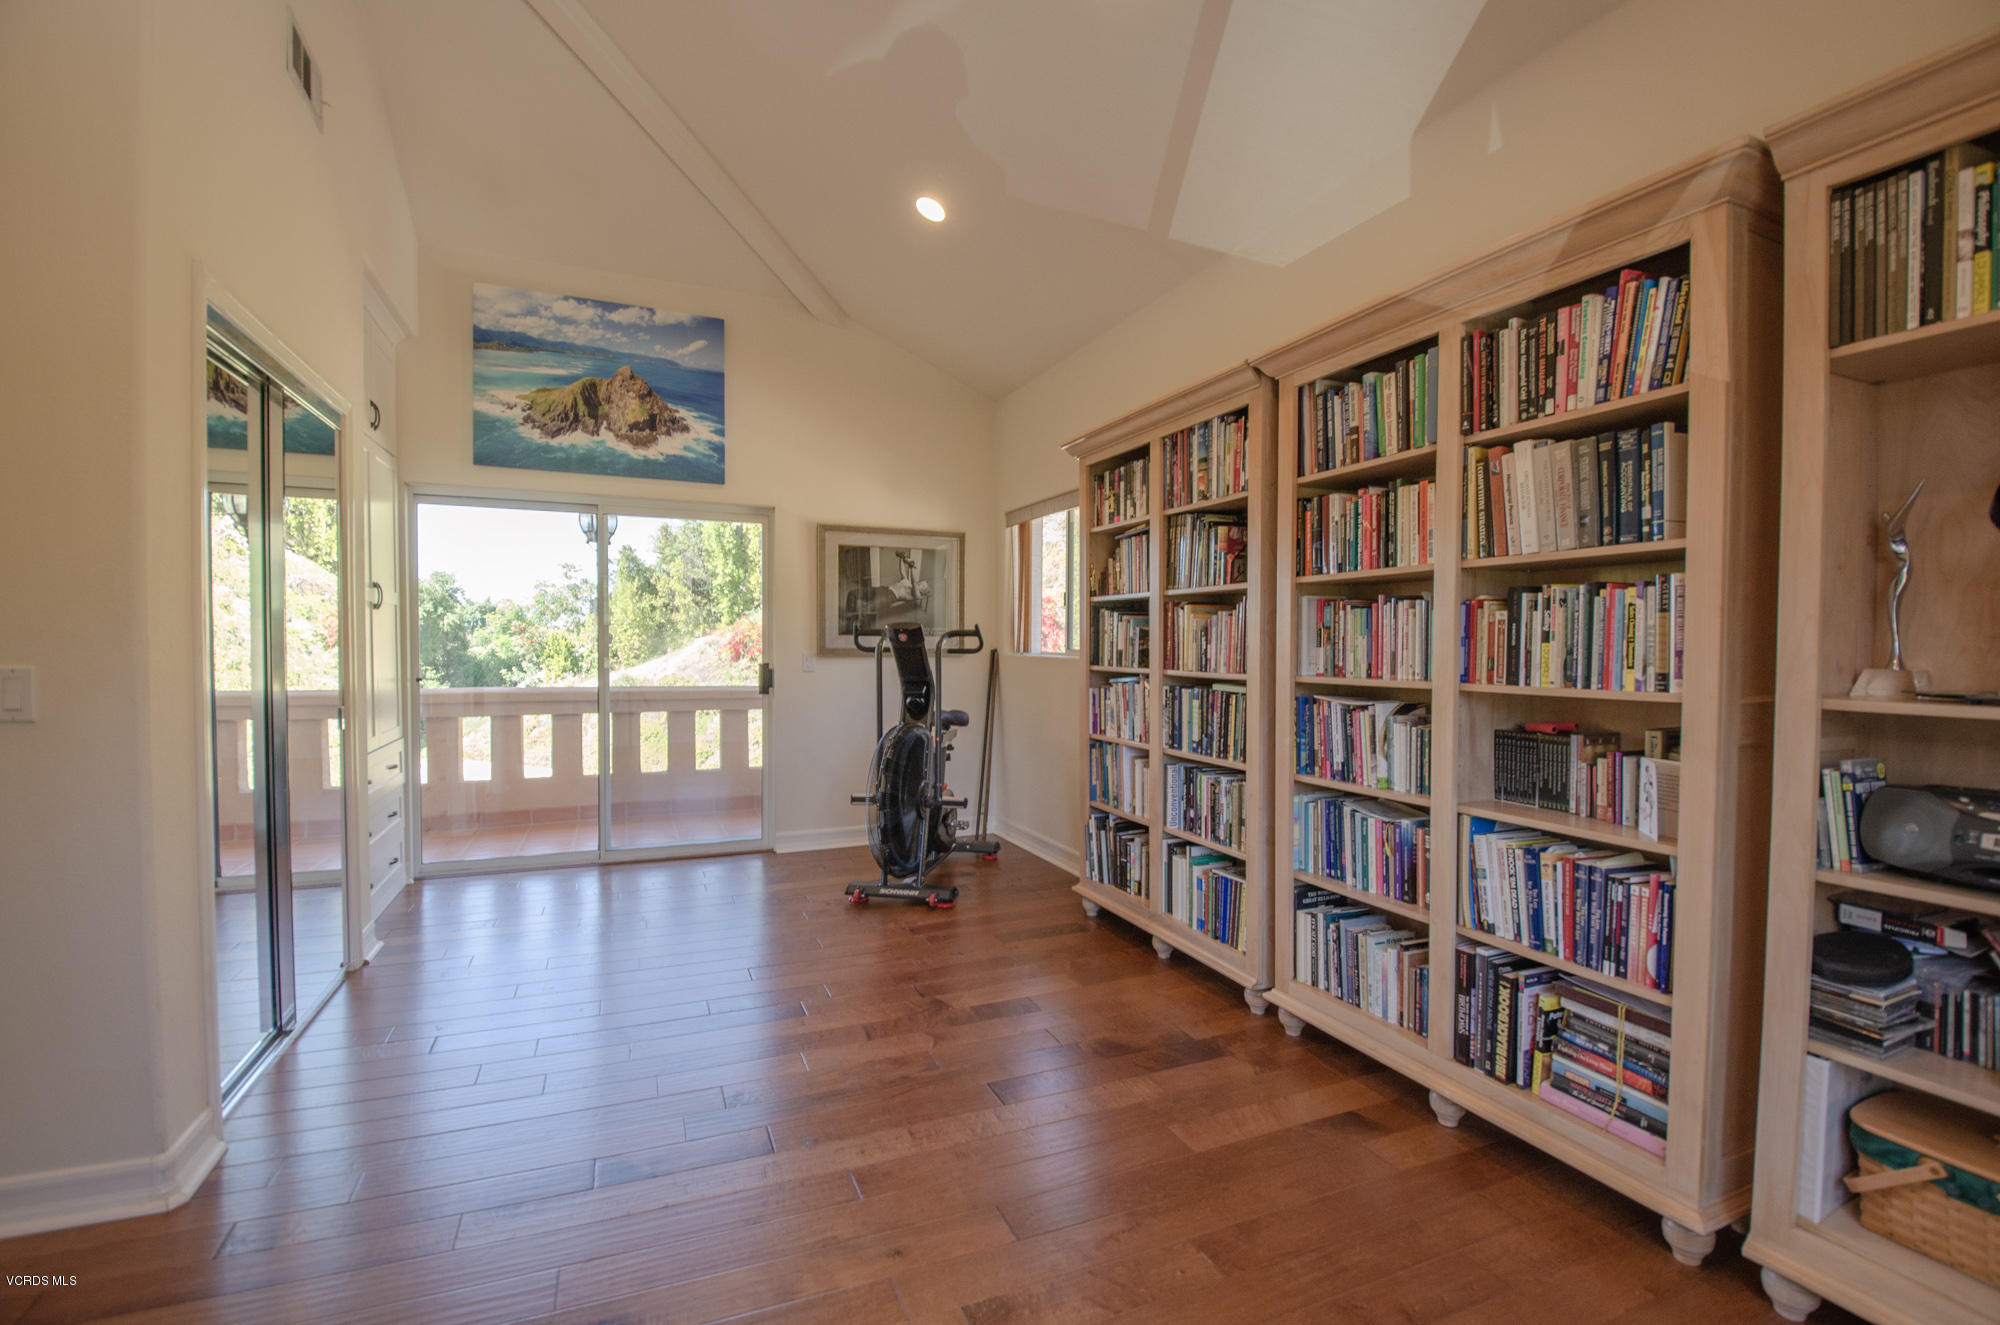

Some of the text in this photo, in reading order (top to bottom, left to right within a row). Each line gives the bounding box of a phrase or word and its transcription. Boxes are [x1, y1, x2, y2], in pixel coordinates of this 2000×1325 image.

[1579, 300, 1590, 379] Flawless Consulting
[1476, 466, 1485, 511] COMPETITIVE
[1170, 766, 1178, 827] Unconventional
